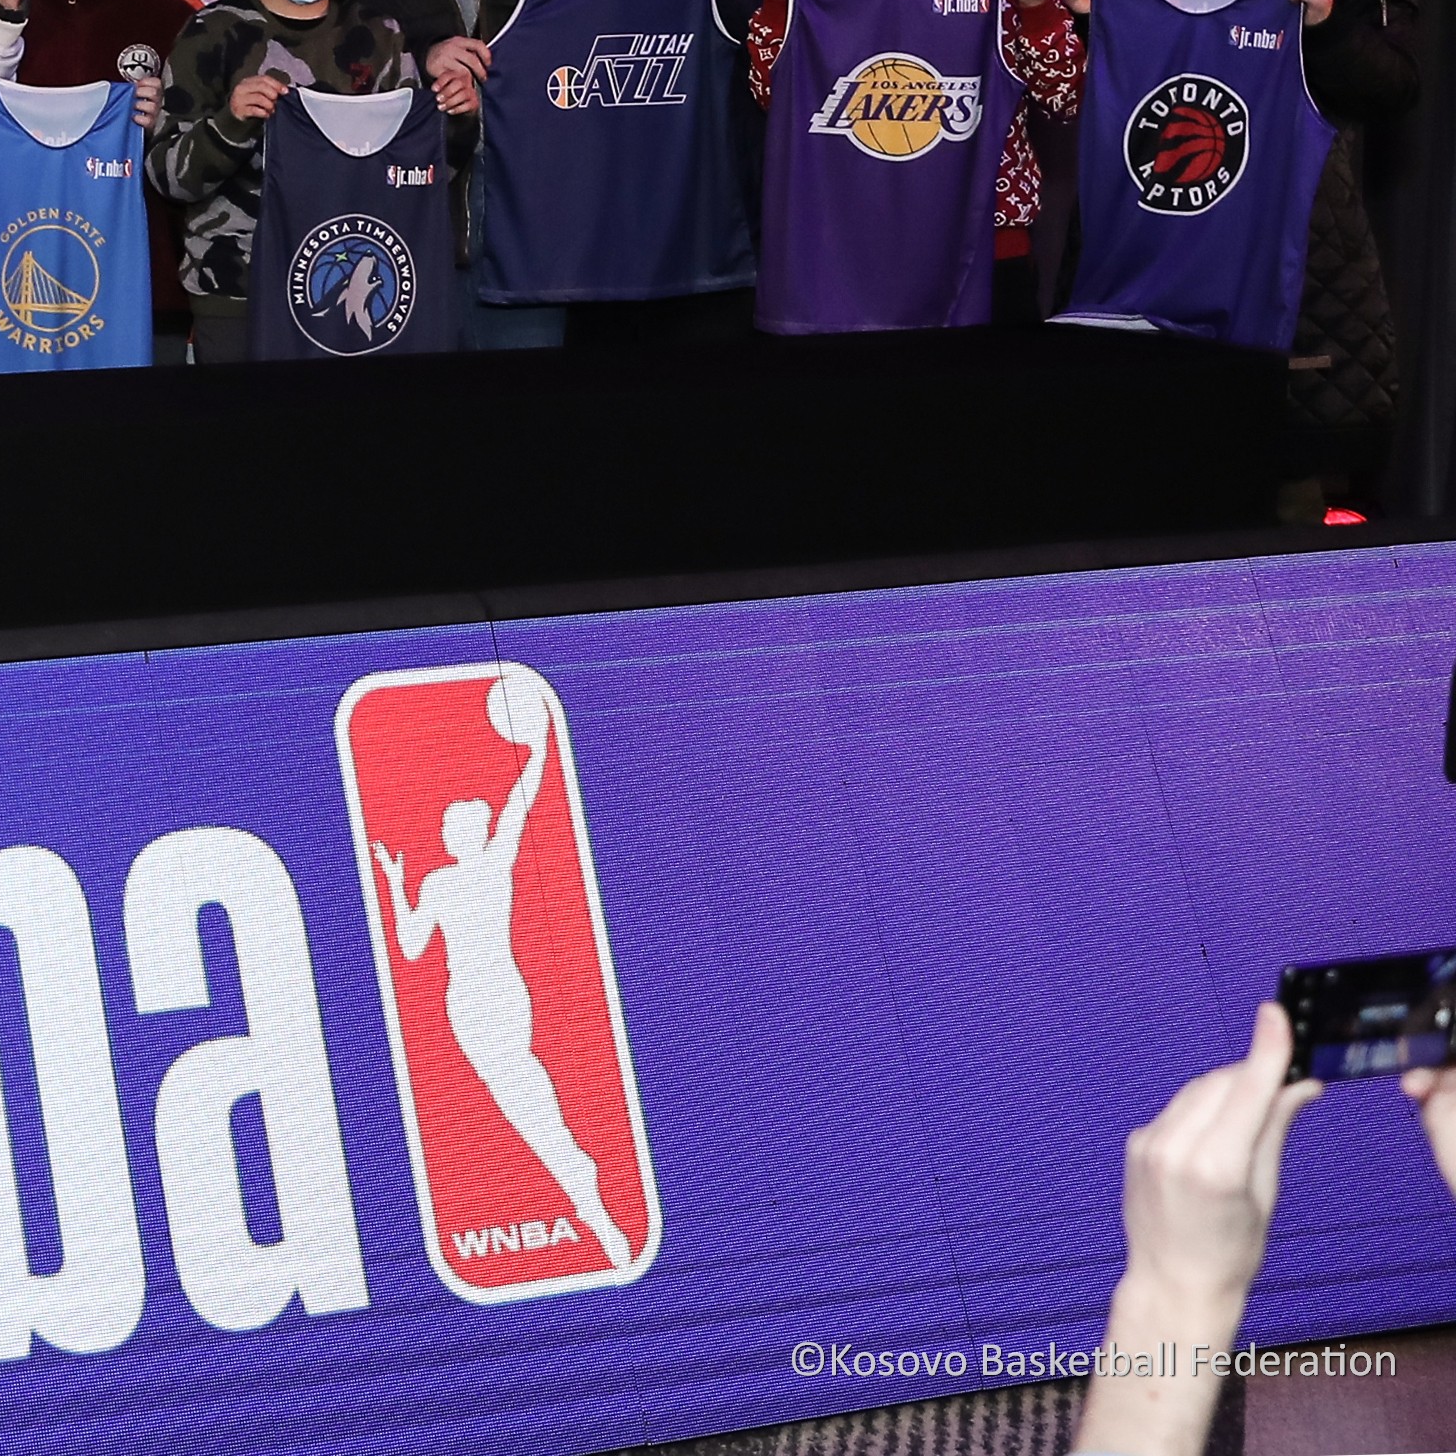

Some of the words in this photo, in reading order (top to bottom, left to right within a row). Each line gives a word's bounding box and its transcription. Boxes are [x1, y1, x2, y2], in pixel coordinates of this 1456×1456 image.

[640, 34, 694, 55] UTAH
[1238, 27, 1276, 49] jr.nba
[870, 80, 898, 90] LOS
[901, 81, 978, 90] ANGELES
[819, 81, 976, 135] LAKERS
[395, 166, 427, 188] jr.nba
[1139, 160, 1230, 206] RPTORS
[0, 208, 59, 243] GOLDEN
[64, 211, 106, 248] STATE
[293, 223, 350, 305] MINNESOTA
[357, 220, 411, 332] TIMBERWOLVES
[451, 1216, 581, 1260] WNBA
